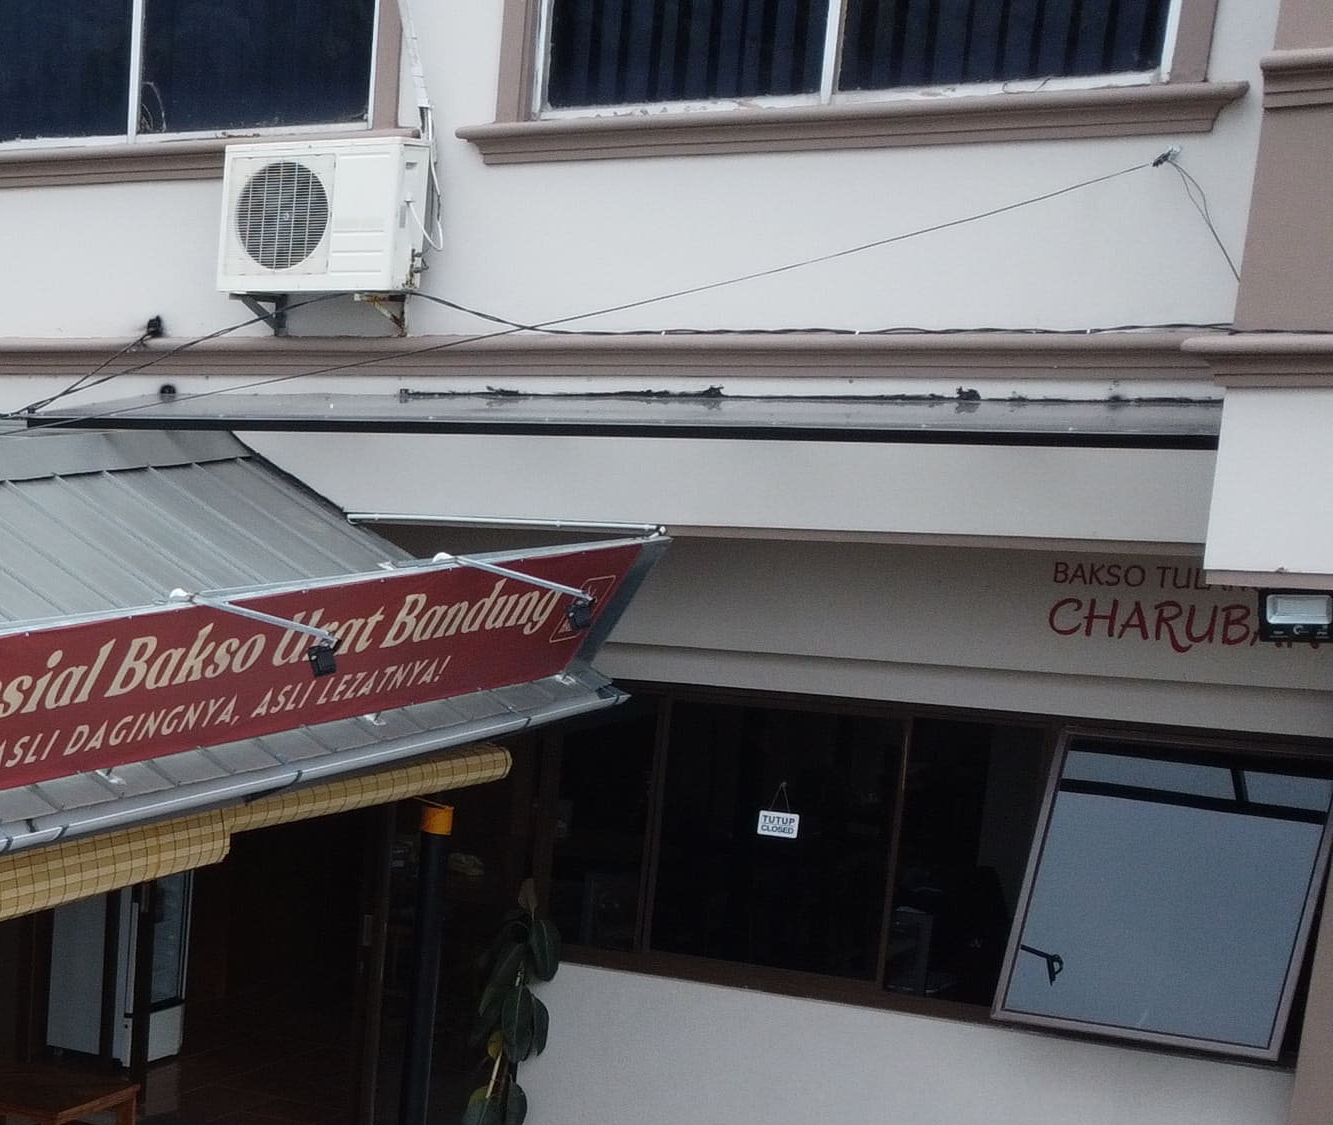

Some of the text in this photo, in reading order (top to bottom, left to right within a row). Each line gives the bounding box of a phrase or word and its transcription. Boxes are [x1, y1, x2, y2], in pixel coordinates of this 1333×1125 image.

[1053, 562, 1146, 588] BAKSO
[103, 622, 266, 698] Bakso
[379, 578, 563, 648] Bandung
[1048, 598, 1321, 653] CHARUB
[63, 693, 239, 757] DAGINGNYA,
[250, 680, 317, 719] ASLI
[316, 656, 452, 704] LEZATNYA!
[761, 825, 794, 835] CLOSED
[762, 815, 795, 825] TUTUP
